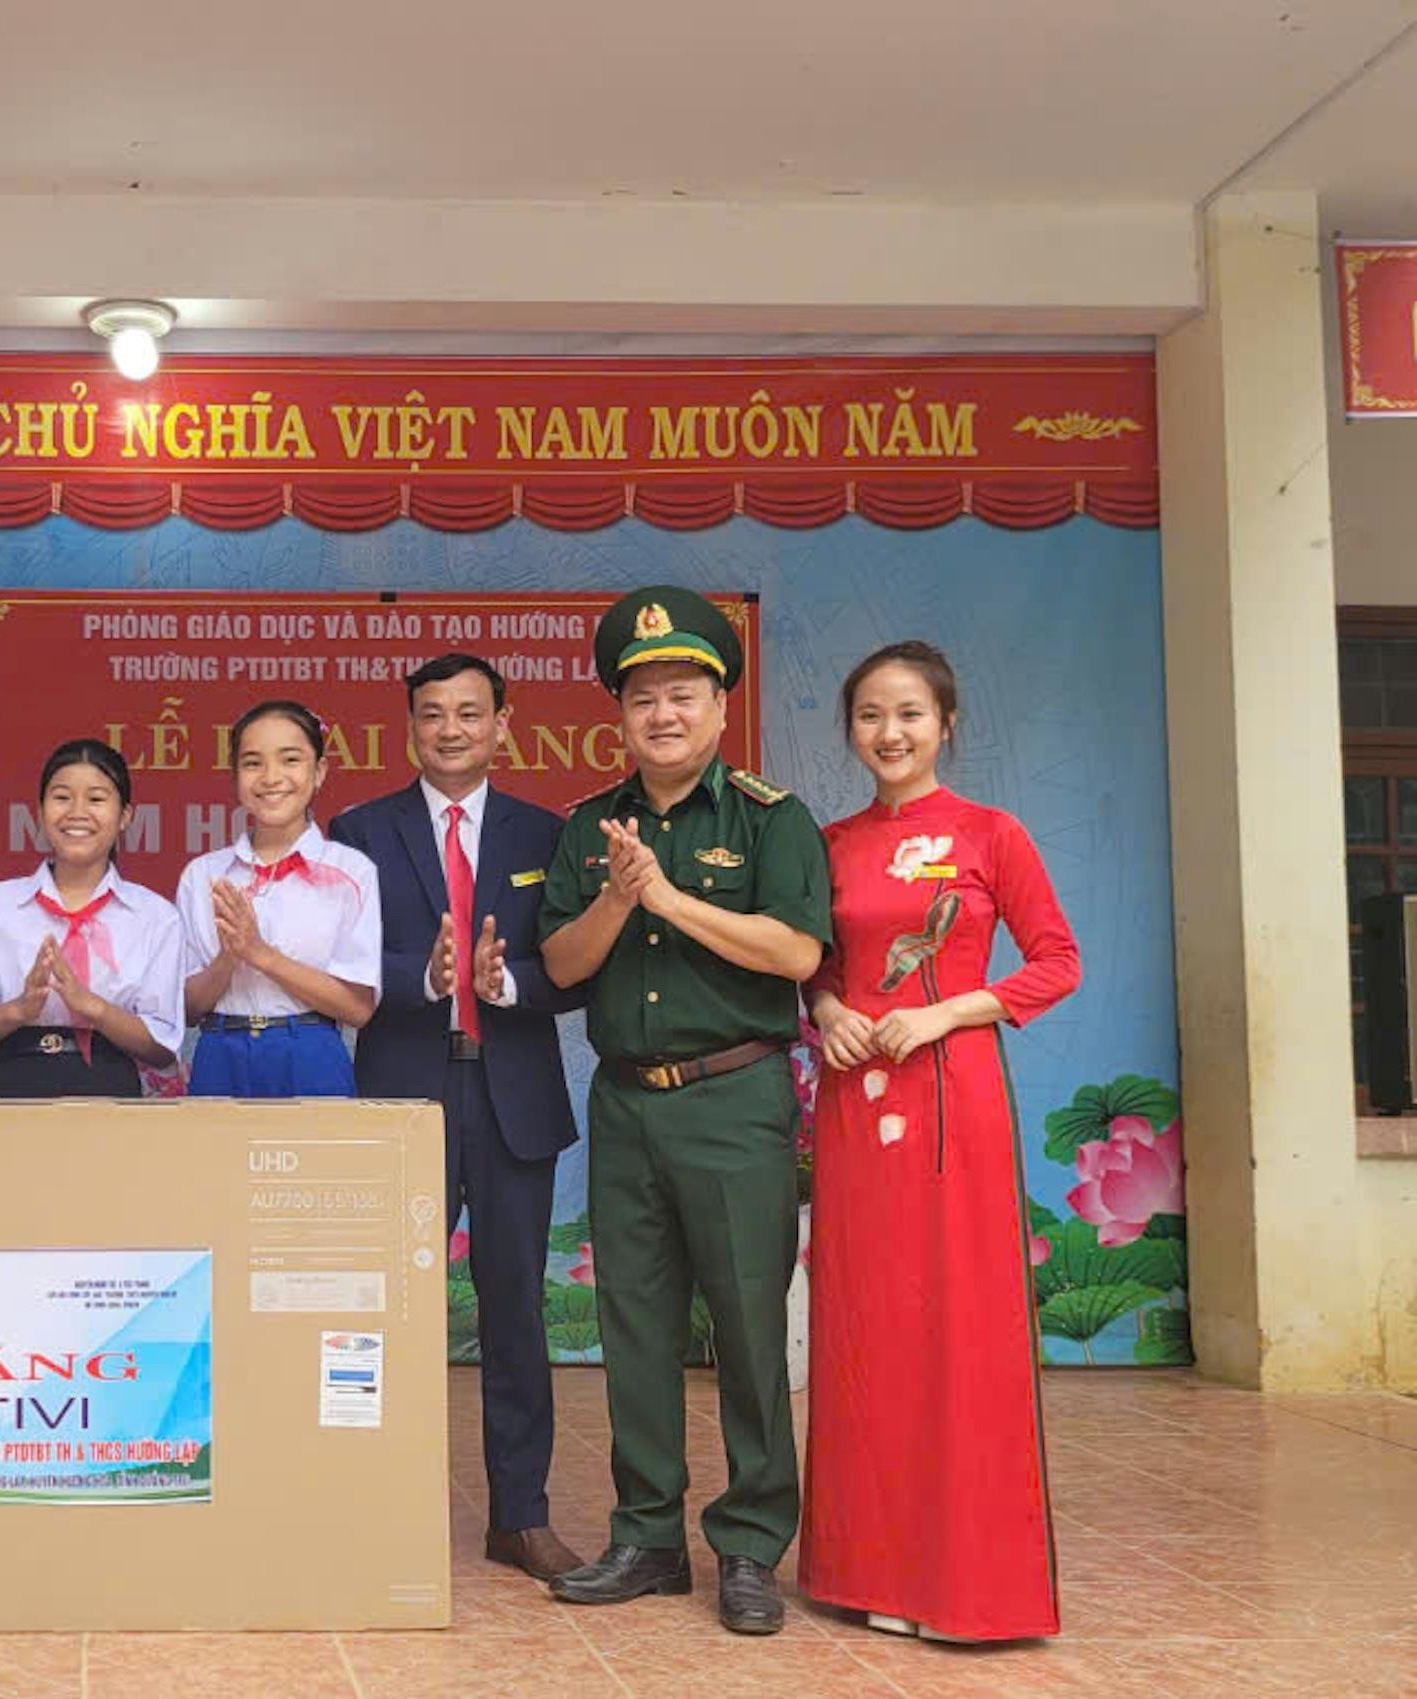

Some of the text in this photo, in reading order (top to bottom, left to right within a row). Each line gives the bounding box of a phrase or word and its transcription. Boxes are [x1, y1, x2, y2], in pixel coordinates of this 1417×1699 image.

[120, 391, 315, 459] NGHĨA
[331, 389, 476, 472] VIỆT
[495, 404, 629, 460] NAM
[648, 389, 824, 460] MUÔN
[842, 387, 978, 457] NĂM
[187, 611, 251, 639] GIÁO
[260, 614, 315, 645] DỤC
[322, 610, 360, 639] VÀ
[432, 614, 481, 645] TẠO
[490, 612, 585, 639] HƯỚNG
[109, 650, 219, 681] TRƯỜNG
[228, 656, 328, 681] PTDTBT
[105, 696, 190, 770] LỄ
[212, 723, 387, 770] AI
[8, 803, 160, 853] NM
[248, 1150, 299, 1172] UHD
[56, 1442, 72, 1462] TH
[89, 1441, 122, 1462] THCS
